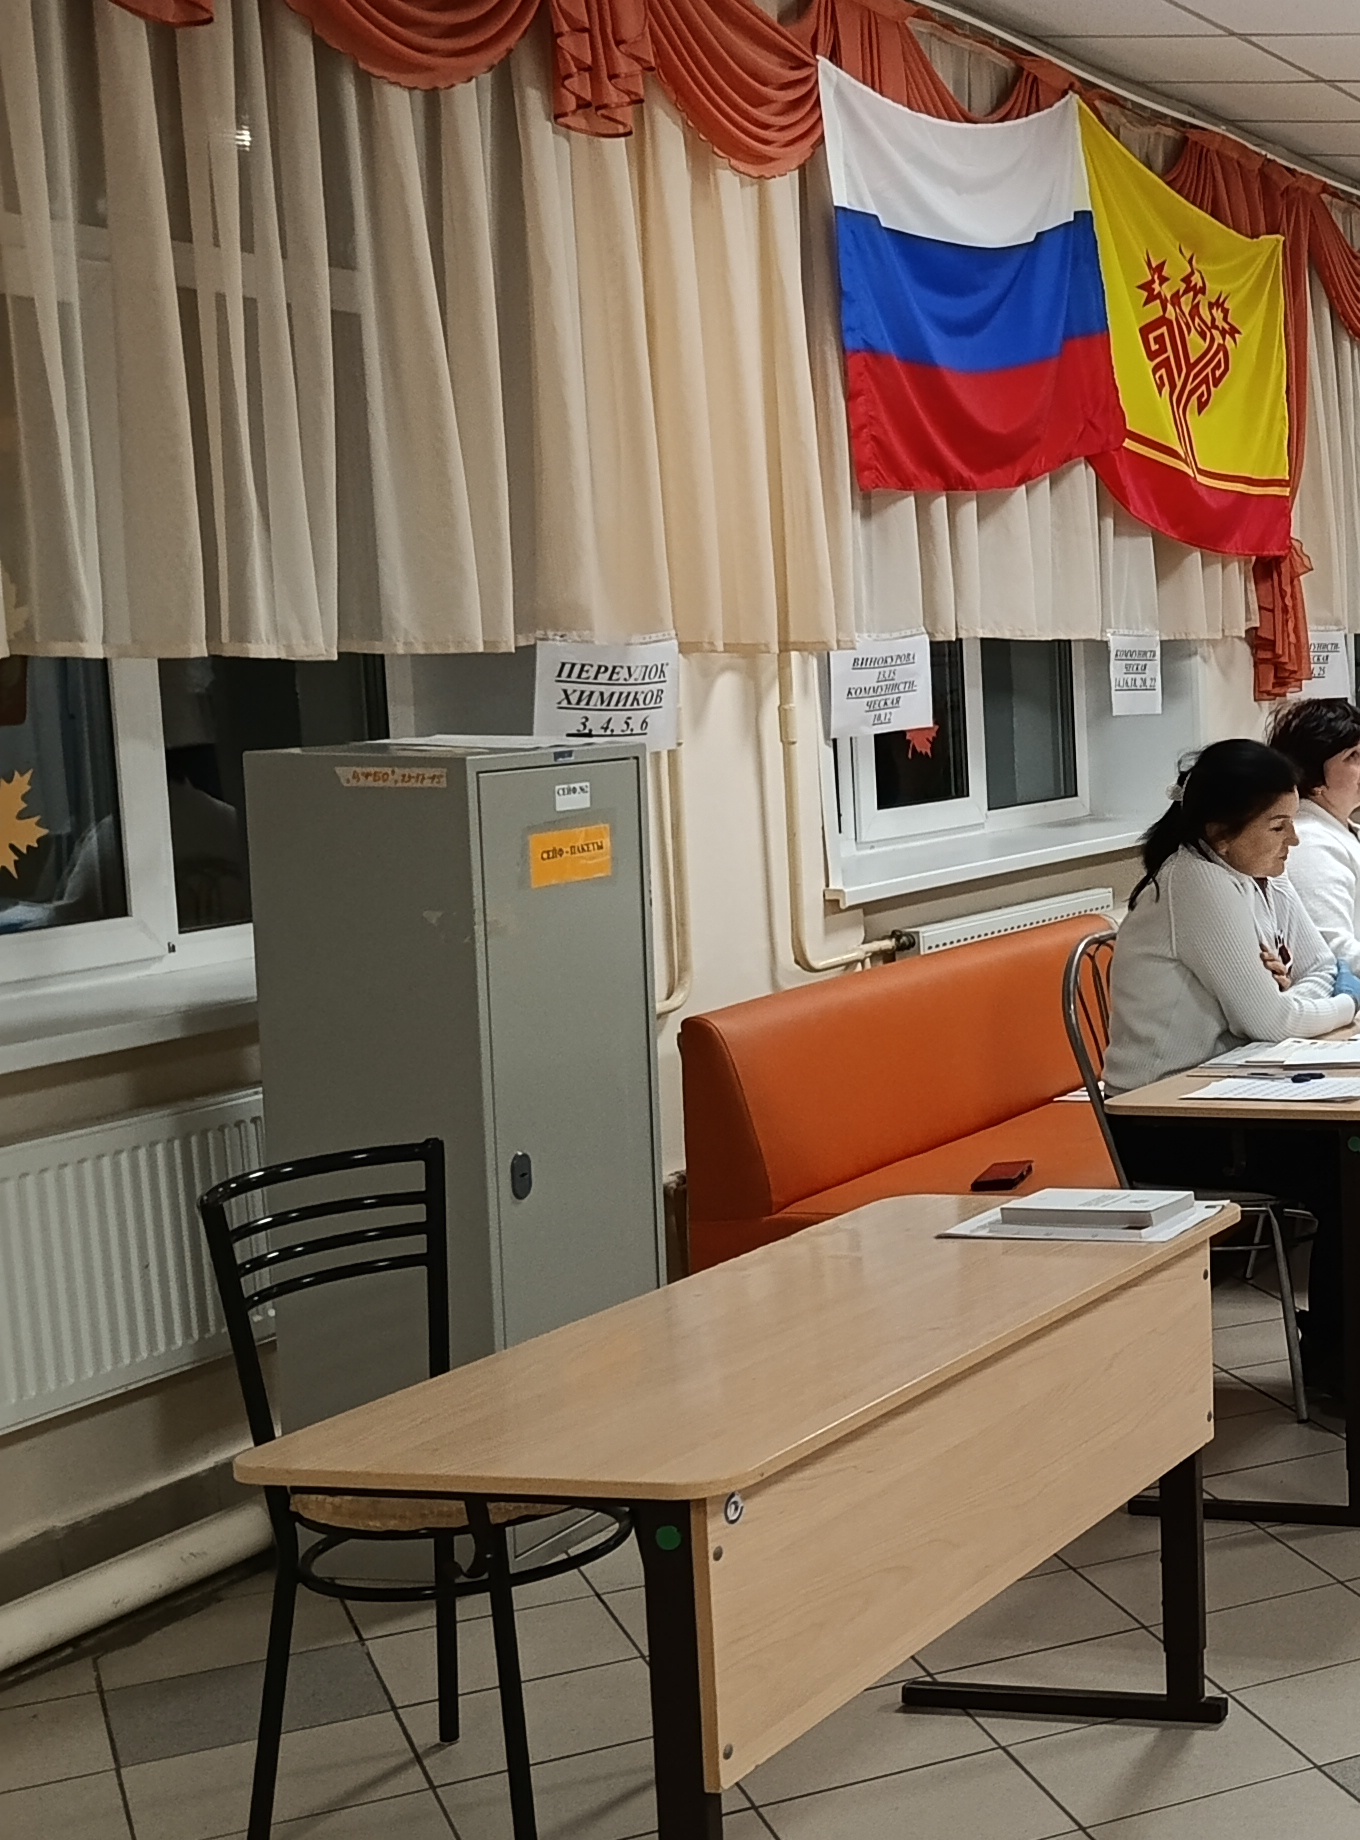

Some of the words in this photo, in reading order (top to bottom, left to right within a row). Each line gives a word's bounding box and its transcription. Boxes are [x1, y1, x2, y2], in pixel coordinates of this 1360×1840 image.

[852, 652, 915, 666] ВИНОКУРОВА
[556, 662, 669, 682] ПЕРЕУЛОК
[846, 680, 918, 697] КОММУНИСТИ-
[556, 688, 664, 707] ХИМИКОВ
[866, 696, 901, 709] ЧЕСКАЯ
[576, 716, 592, 733] 3,
[600, 716, 614, 733] 4,
[621, 716, 634, 733] 5,
[640, 715, 650, 731] 6
[557, 785, 578, 796] СЕЙФ
[570, 841, 604, 856] ПАКЕТЫ
